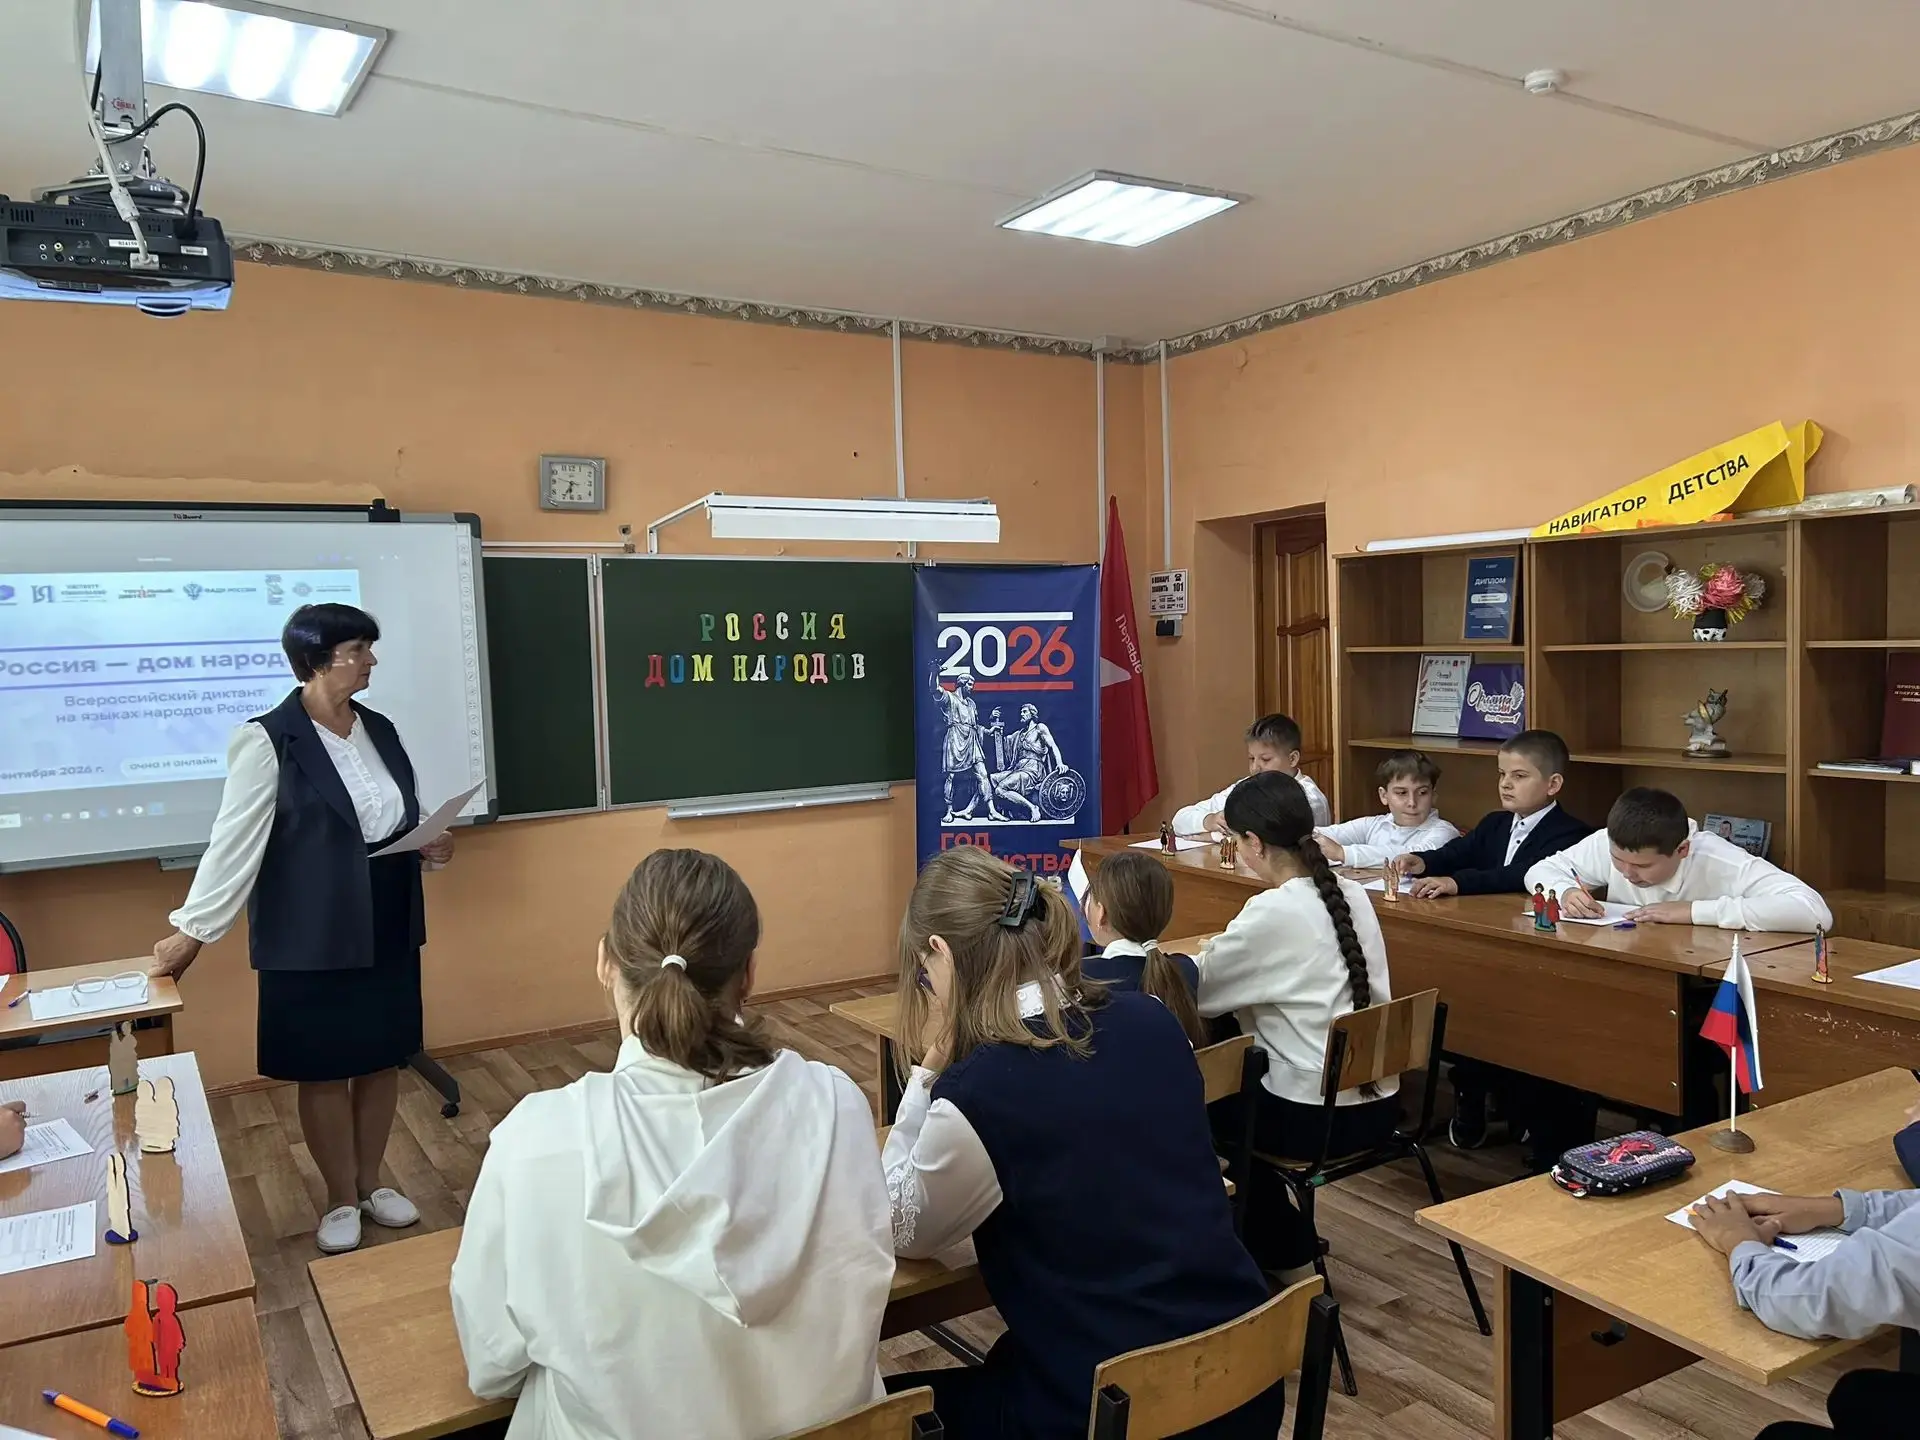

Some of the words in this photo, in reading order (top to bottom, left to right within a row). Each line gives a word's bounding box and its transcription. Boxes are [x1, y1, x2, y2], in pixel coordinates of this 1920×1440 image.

[1549, 495, 1647, 534] НАВИГАТОР
[1668, 454, 1750, 504] ДЕТСТВА
[1173, 582, 1184, 592] 101
[1474, 577, 1506, 586] ДИПЛОМ
[700, 612, 846, 642] РОССИЯ
[937, 626, 1075, 677] 2026
[1115, 614, 1144, 674] Первые
[137, 654, 192, 673] дом
[202, 652, 287, 671] народ
[645, 654, 715, 688] ДОМ
[732, 653, 866, 684] НАРОДОВ
[64, 689, 197, 707] Всероссийский
[201, 688, 266, 702] диктант
[56, 714, 76, 724] на
[81, 711, 139, 722] языках
[143, 708, 213, 720] народов
[217, 703, 274, 714] России
[0, 769, 57, 780] ентября
[59, 765, 93, 776] 2026
[163, 760, 171, 769] и
[173, 756, 218, 767] онлайн
[941, 832, 992, 852] ГОД
[998, 853, 1072, 872] СТВА
